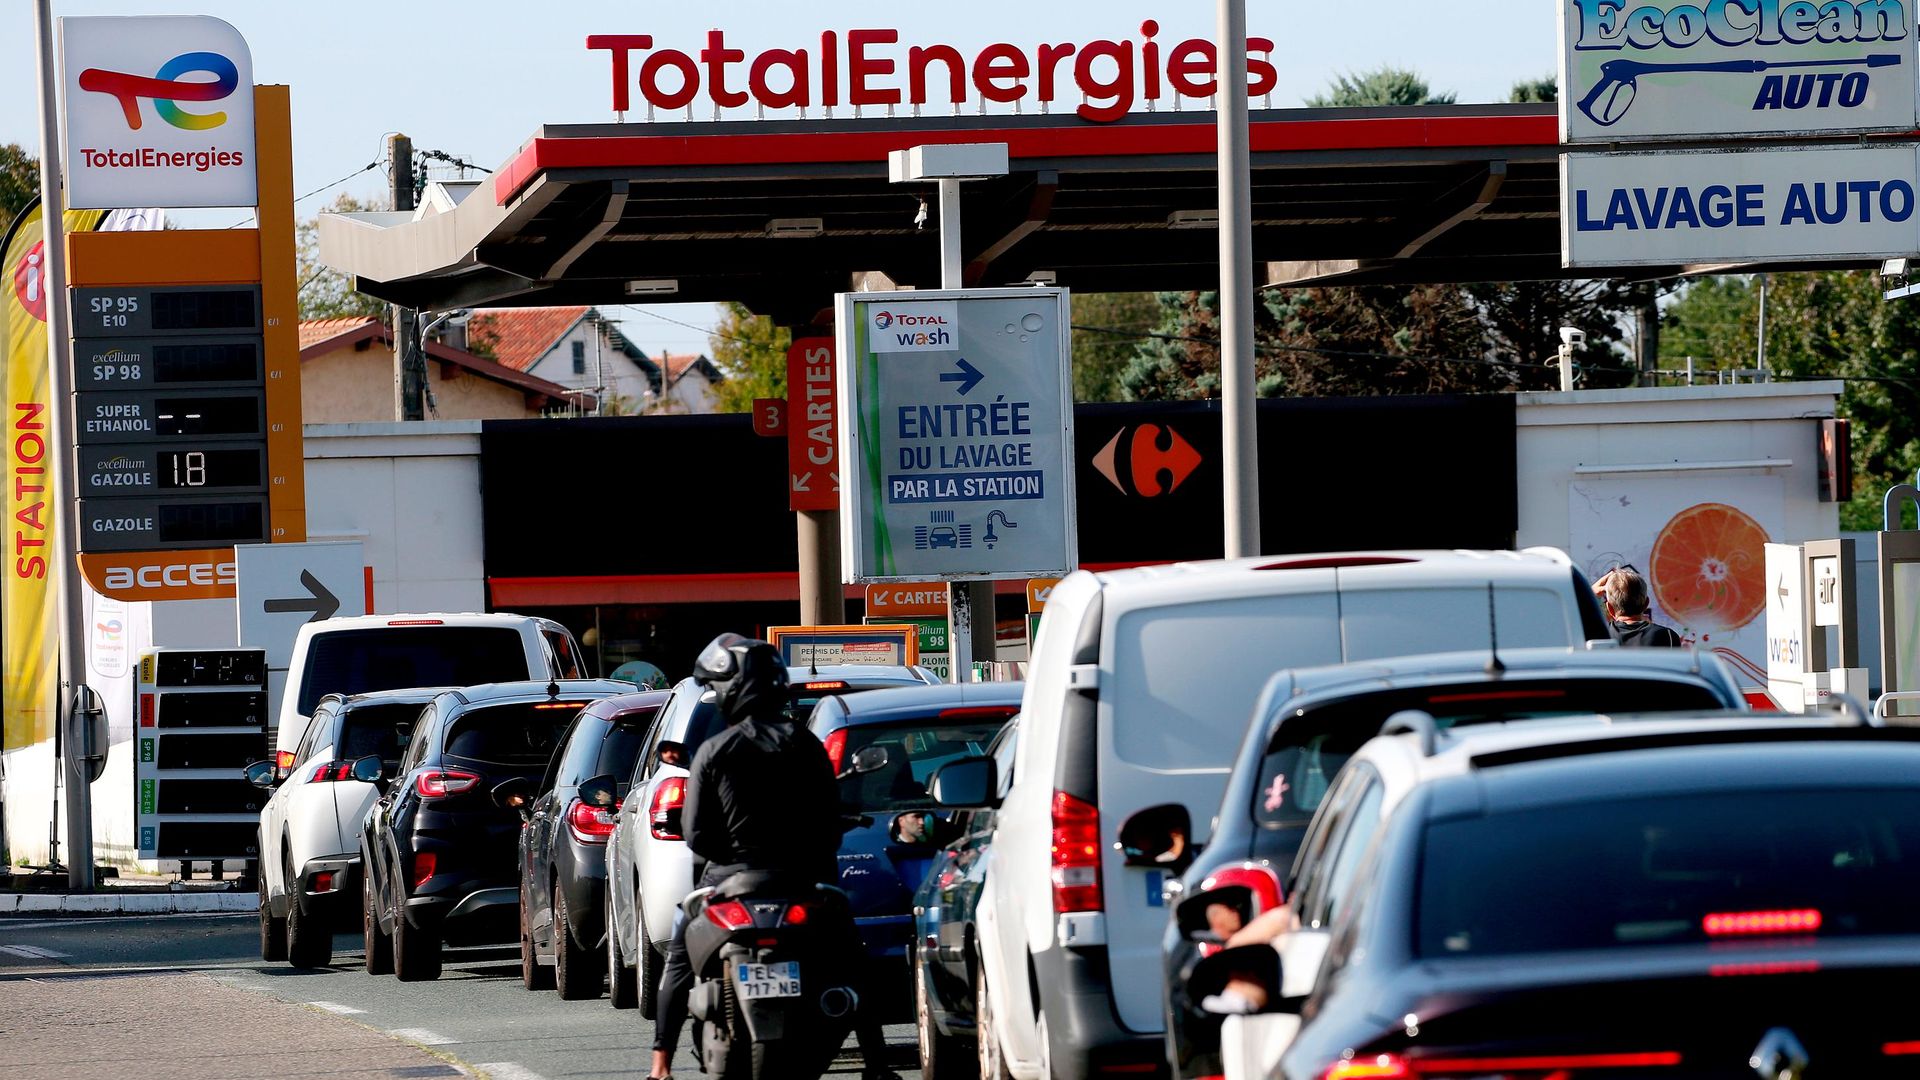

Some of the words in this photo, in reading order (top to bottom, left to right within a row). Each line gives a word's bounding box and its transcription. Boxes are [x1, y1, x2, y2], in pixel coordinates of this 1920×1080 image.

[1575, 0, 1908, 50] EcoClean
[586, 20, 1278, 122] TotalEnergies
[1752, 72, 1870, 111] AUTO
[80, 147, 243, 172] TotalEnergies
[1576, 184, 1766, 231] LAVAGE
[1780, 179, 1915, 225] AUTO
[91, 297, 113, 313] SP
[117, 297, 138, 312] 95
[103, 315, 127, 327] E10
[896, 314, 947, 326] TOTAL
[896, 328, 949, 346] wash
[92, 351, 140, 362] excellium
[93, 365, 115, 381] SP
[120, 365, 141, 380] 98
[96, 405, 140, 418] SUPER
[805, 347, 833, 465] CARTES
[87, 419, 151, 432] ETHANOL
[766, 406, 779, 429] 3
[898, 395, 1031, 438] ENTRÉE
[97, 458, 145, 470] excellium
[900, 446, 931, 470] DU
[940, 443, 1032, 468] LAVAGE
[91, 473, 151, 487] GAZOLE
[893, 480, 929, 499] PAR
[935, 479, 958, 497] LA
[963, 476, 1039, 497] STATION
[15, 403, 46, 579] STATION
[93, 518, 153, 532] GAZOLE
[894, 591, 947, 605] CARTES
[930, 636, 944, 646] 98
[1770, 629, 1800, 664] wash
